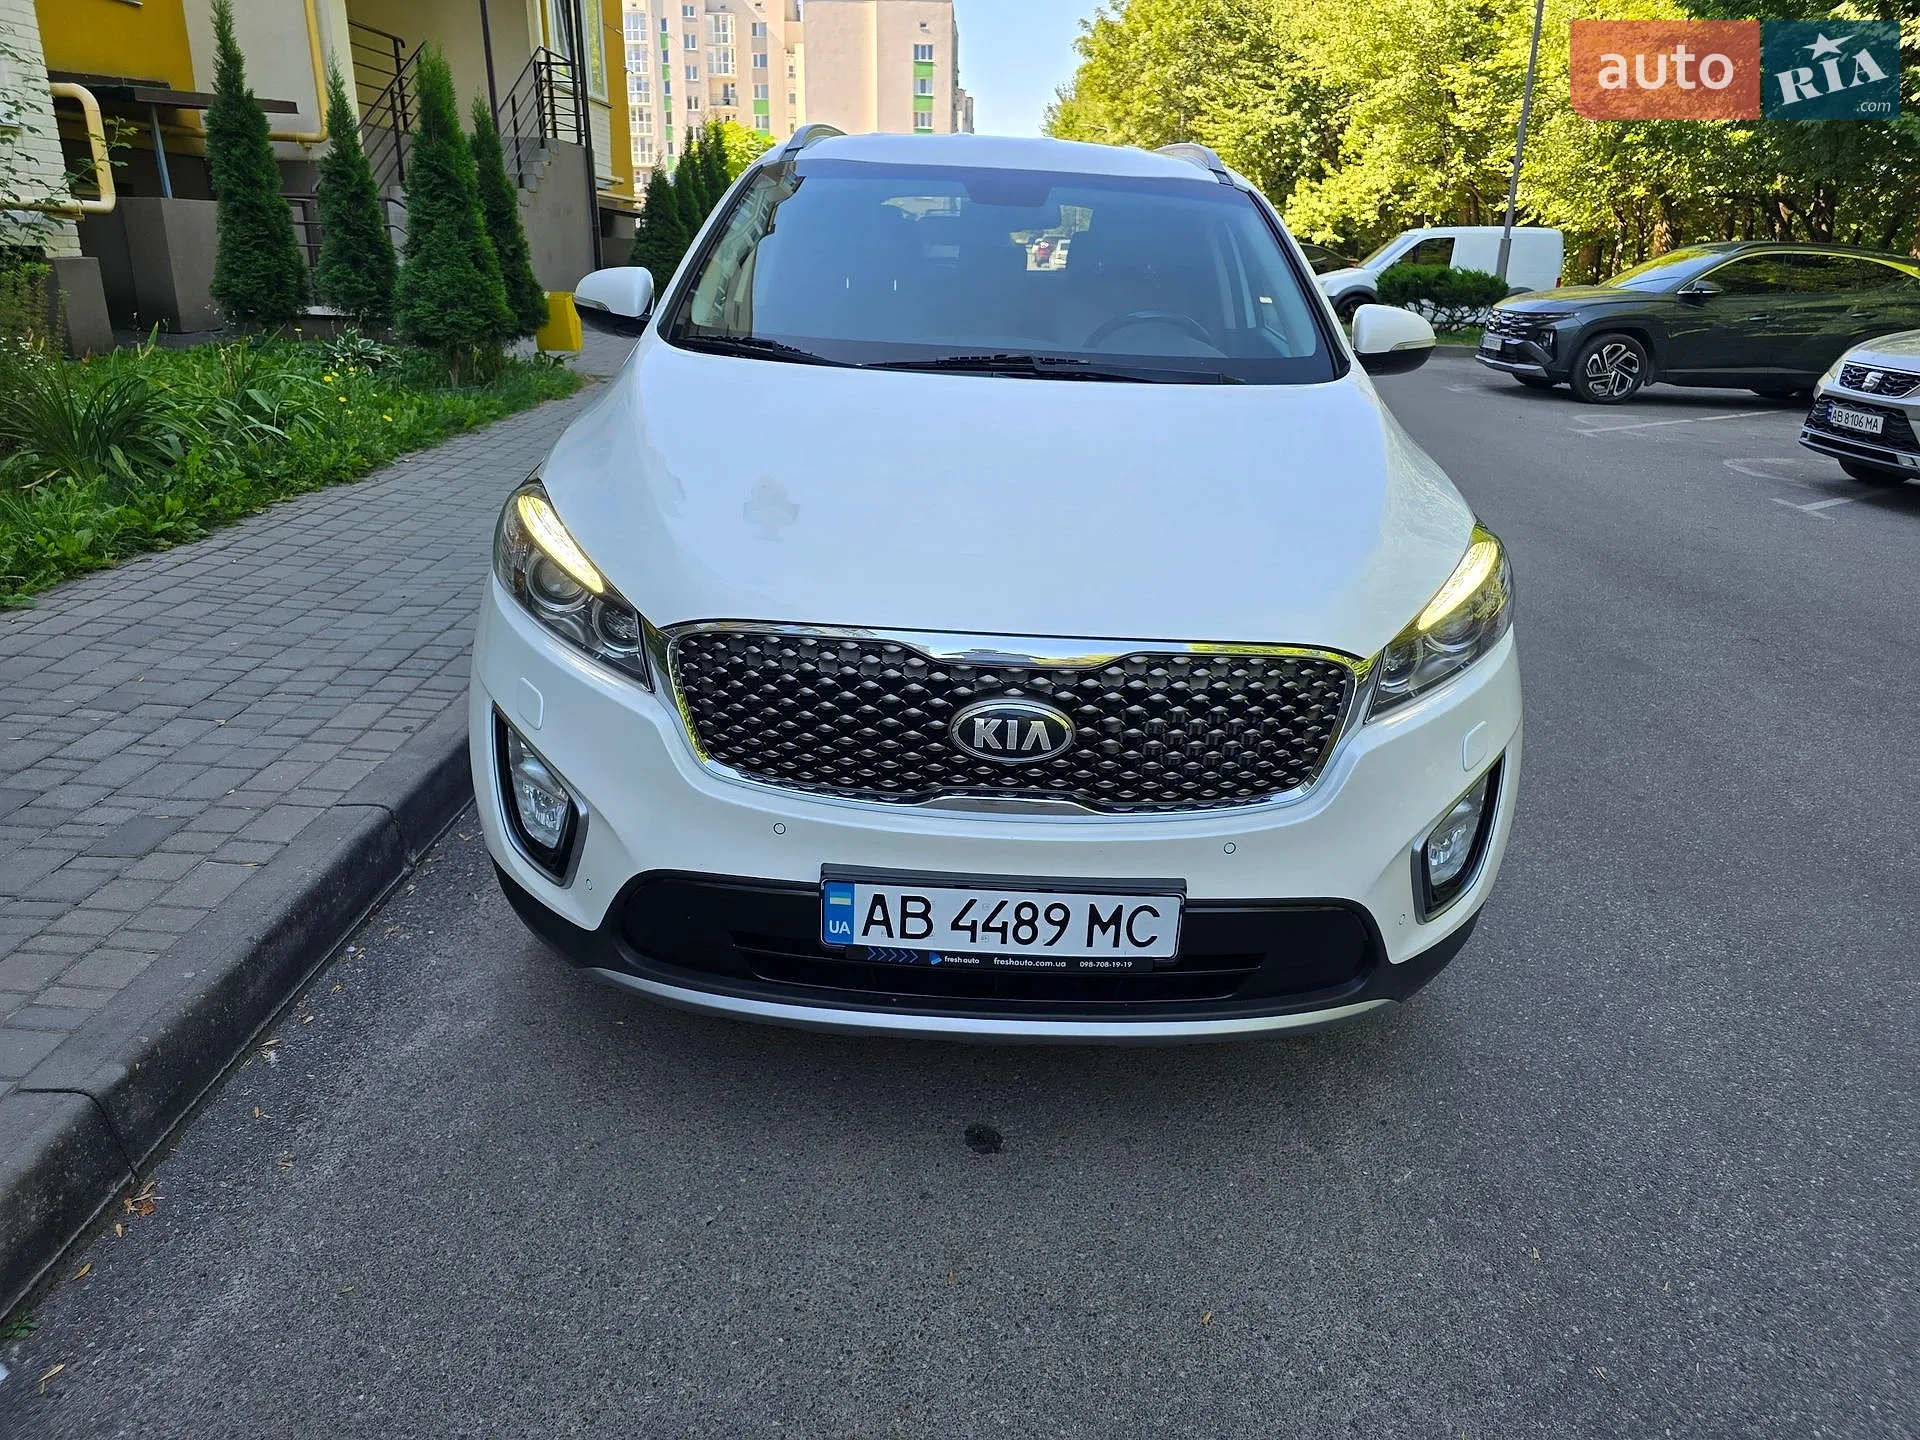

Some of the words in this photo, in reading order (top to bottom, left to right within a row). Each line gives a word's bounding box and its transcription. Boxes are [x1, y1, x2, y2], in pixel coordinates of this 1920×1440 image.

[1831, 409, 1843, 423] AB
[1844, 412, 1864, 428] 8106
[1865, 416, 1878, 430] MA
[974, 717, 1052, 751] KIA
[829, 919, 851, 935] UA
[861, 893, 934, 939] AB
[950, 898, 1071, 947] 4489
[1086, 903, 1160, 949] MC
[993, 956, 1067, 968] freshauto.com.ua
[1079, 960, 1133, 968] 098-708-19-19
